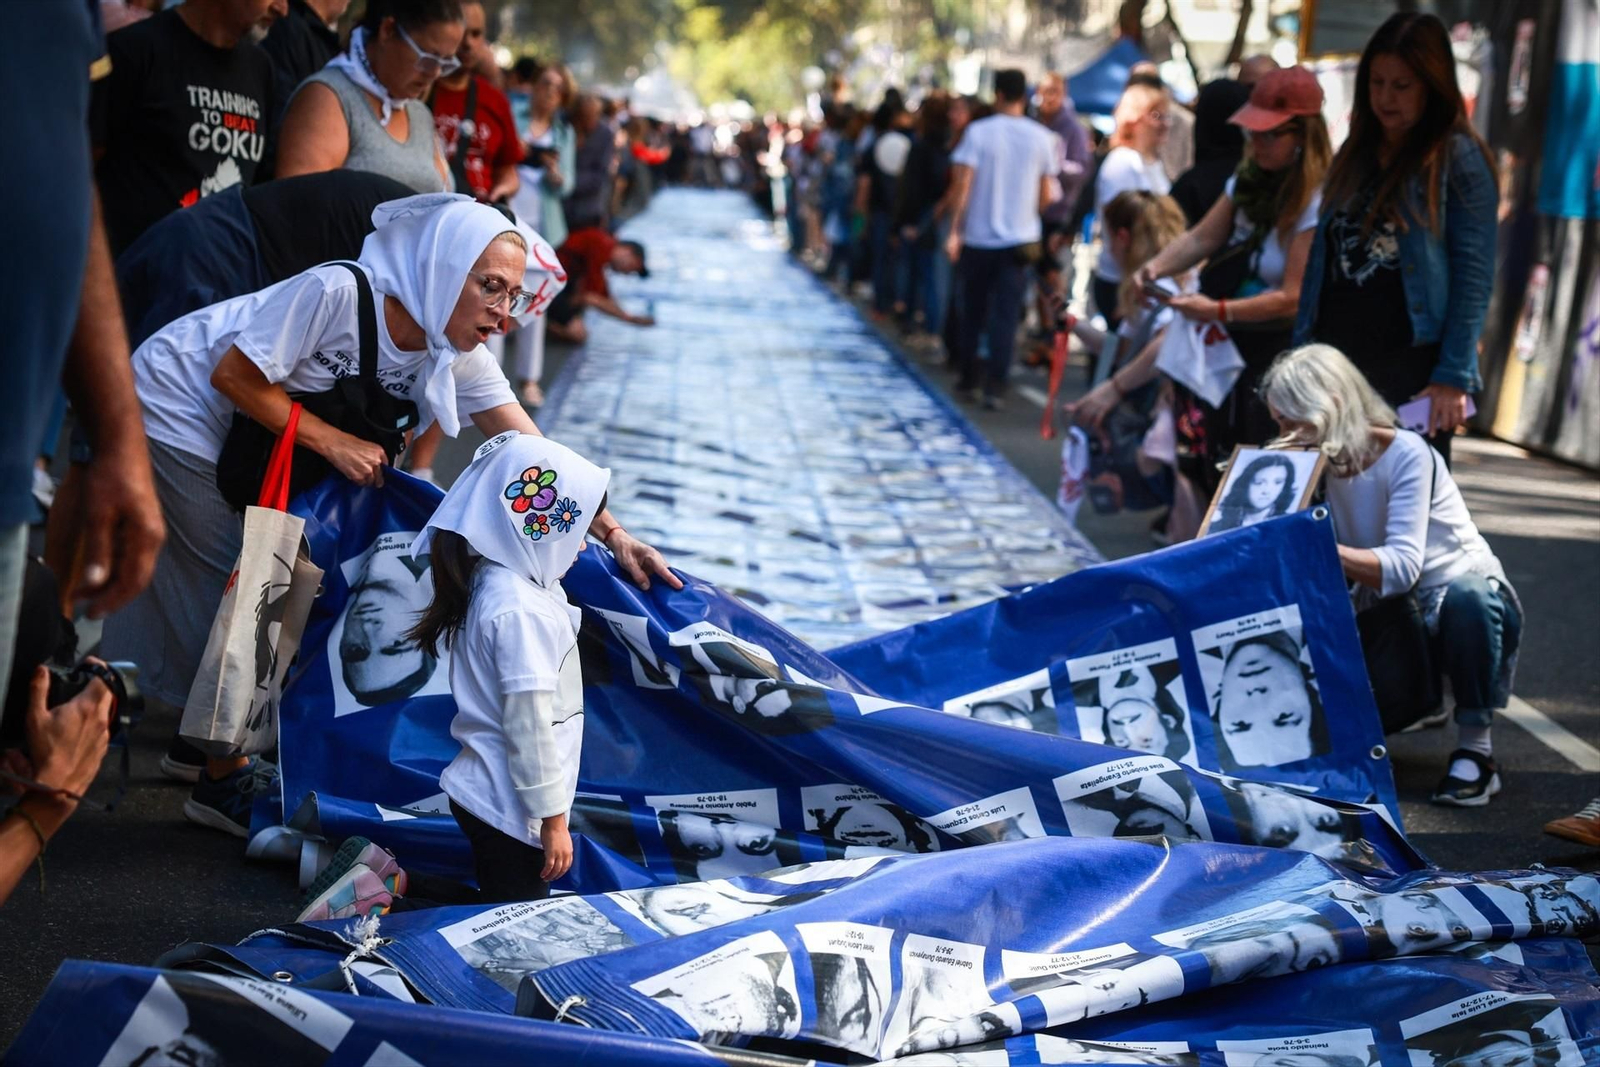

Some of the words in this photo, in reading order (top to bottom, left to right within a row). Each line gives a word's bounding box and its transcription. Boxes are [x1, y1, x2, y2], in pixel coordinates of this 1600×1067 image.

[187, 85, 260, 120] TRAINING
[201, 109, 221, 125] TO
[223, 112, 257, 134] BEAT
[188, 122, 264, 162] GOKU
[334, 350, 352, 366] 1976
[1107, 761, 1135, 773] 25-11-77
[1122, 766, 1149, 776] Roberto
[1080, 773, 1122, 790] Evangelista
[969, 810, 991, 820] Carlos
[990, 805, 1007, 814] Luis
[511, 906, 535, 918] Edith
[471, 916, 511, 934] Edelberg
[935, 955, 955, 966] Eduardo
[954, 959, 973, 970] Gabriel
[1460, 994, 1496, 1009] 17-12-76
[1487, 996, 1508, 1007] José
[1468, 1003, 1487, 1013] Luis
[1290, 1042, 1329, 1050] Reinaldo
